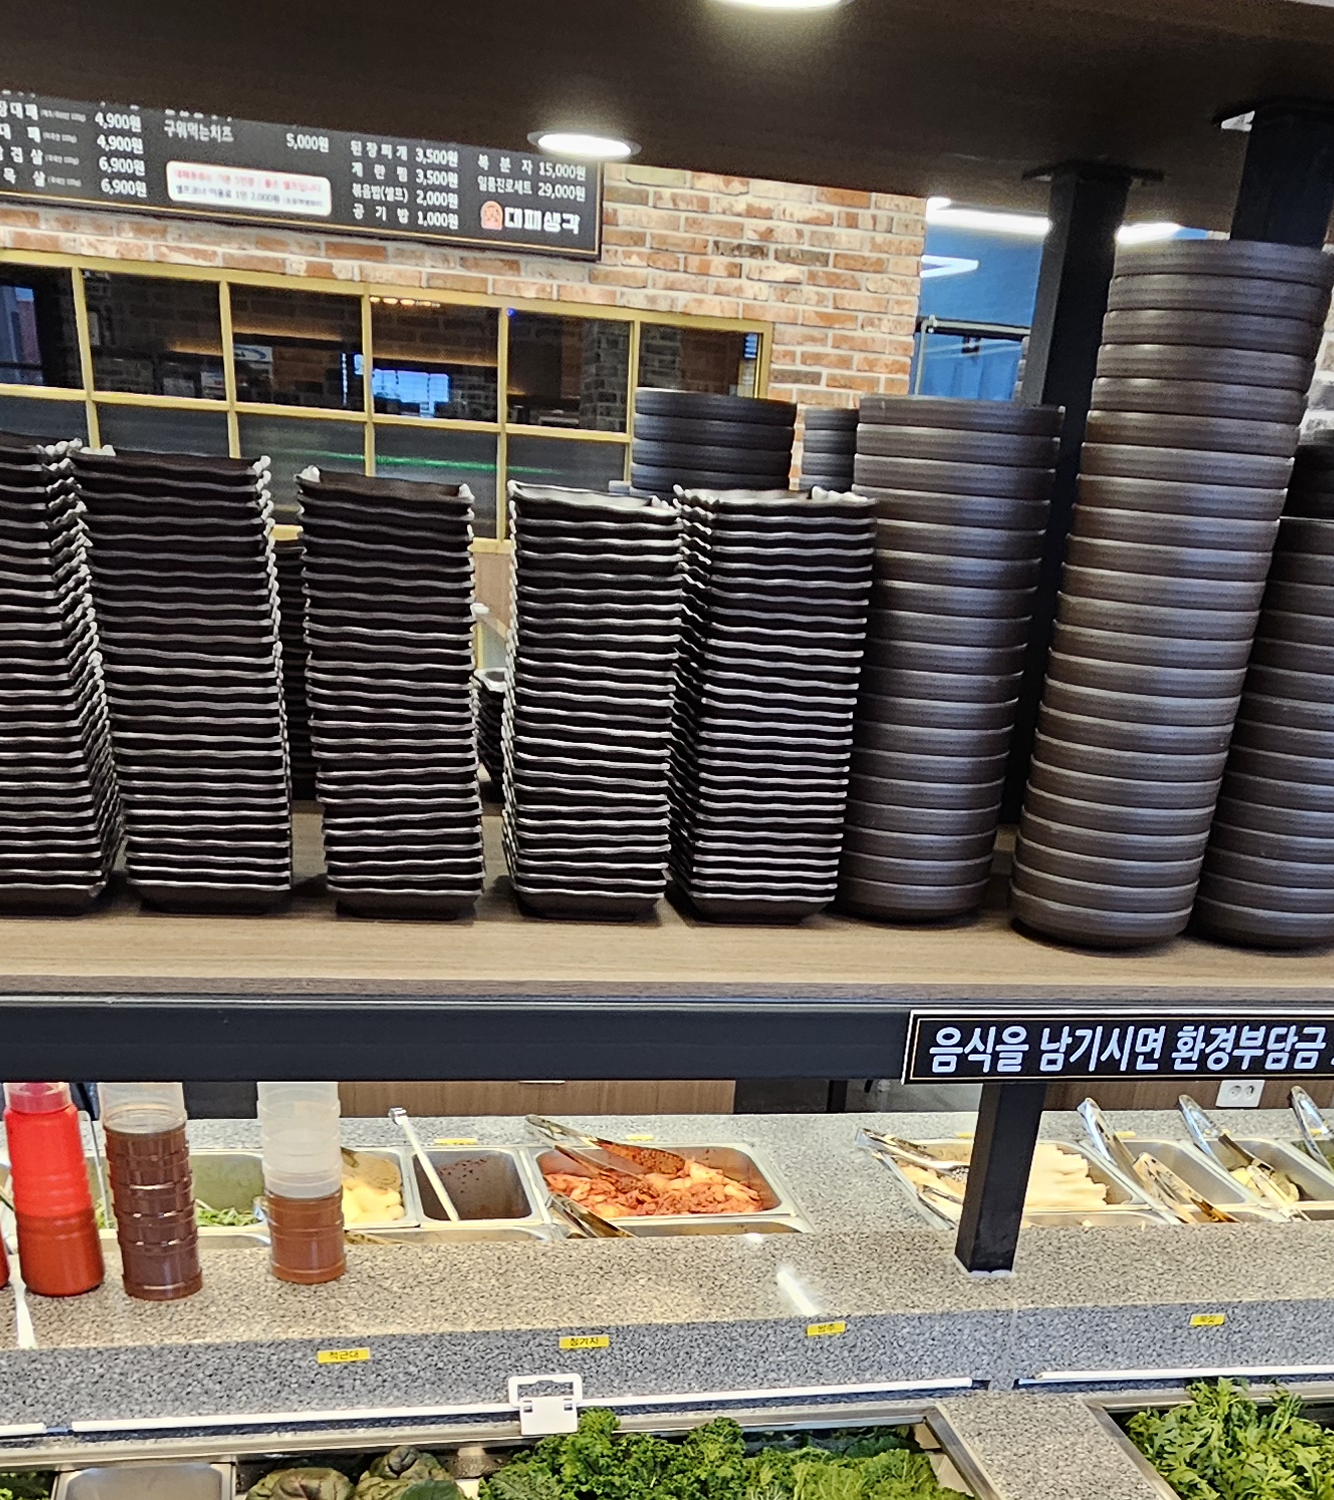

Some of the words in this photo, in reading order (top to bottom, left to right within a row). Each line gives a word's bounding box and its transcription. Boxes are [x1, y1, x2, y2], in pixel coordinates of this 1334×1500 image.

[94, 112, 142, 132] 4,900원
[97, 134, 144, 154] 4,900원
[164, 119, 234, 143] 구워먹는치즈
[286, 132, 329, 153] 5,000원
[98, 156, 146, 176] 6,900원
[415, 147, 458, 167] 3,500원
[415, 168, 458, 188] 3,500원
[538, 161, 586, 181] 15,000원
[100, 177, 148, 198] 6,900원
[537, 182, 586, 202] 29,000원
[416, 189, 458, 209] 2,000원
[417, 210, 458, 230] 1,000원
[504, 206, 580, 235] 대패생각
[929, 1025, 1030, 1073] 음식을
[1039, 1025, 1167, 1072] 남기시면
[1171, 1025, 1327, 1071] 환경부담금
